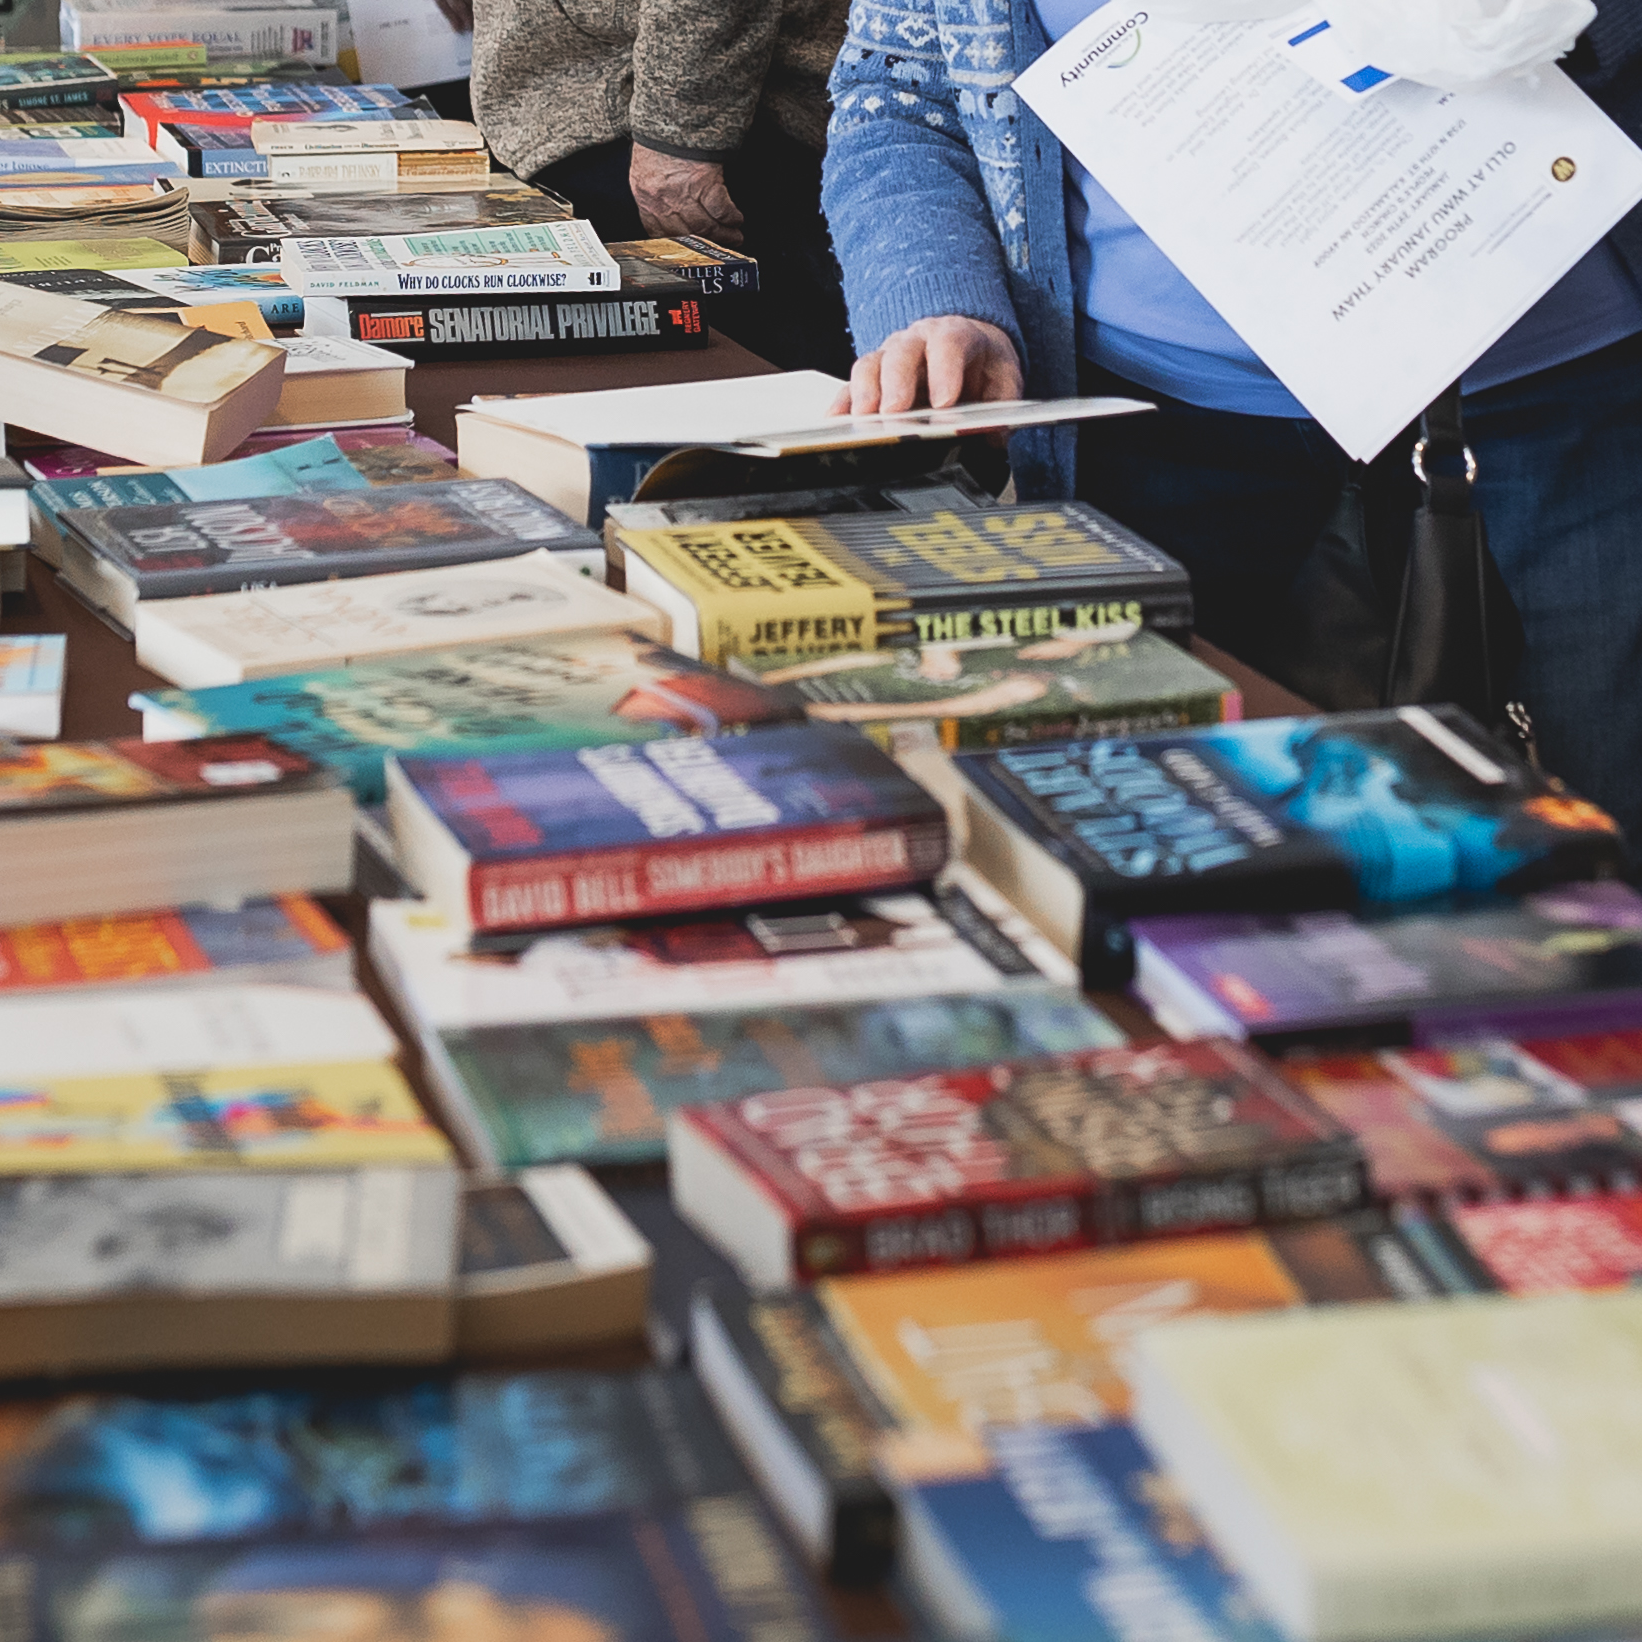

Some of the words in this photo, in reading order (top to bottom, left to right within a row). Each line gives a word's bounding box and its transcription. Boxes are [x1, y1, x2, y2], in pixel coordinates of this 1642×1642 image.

[191, 30, 243, 44] EQUAL
[1058, 10, 1150, 90] Community
[1483, 139, 1518, 172] OLLI
[1407, 170, 1452, 213] JANUARY
[1464, 169, 1487, 192] AT
[1348, 175, 1407, 232] KALAMAZOO
[1428, 186, 1469, 226] WMU
[1369, 220, 1435, 283] JANUARY
[1402, 211, 1474, 281] PROGRAM
[309, 281, 335, 289] DAVID
[338, 280, 380, 288] FELDMAN
[397, 273, 423, 290] WHY
[425, 275, 439, 289] DO
[441, 274, 481, 289] CLOCKS
[483, 274, 504, 288] RUN
[507, 272, 567, 288] CLOCKWISE?
[1329, 278, 1374, 322] THAW
[358, 312, 425, 341] Damore
[429, 304, 555, 344] SENATORIAL
[557, 300, 661, 340] PRIVILEGE
[747, 615, 861, 645] JEFFERY
[915, 613, 970, 643] THE
[976, 606, 1059, 640] STEEL
[1074, 600, 1143, 632] KISS
[482, 868, 567, 927] DAVID
[573, 862, 641, 916] BELL
